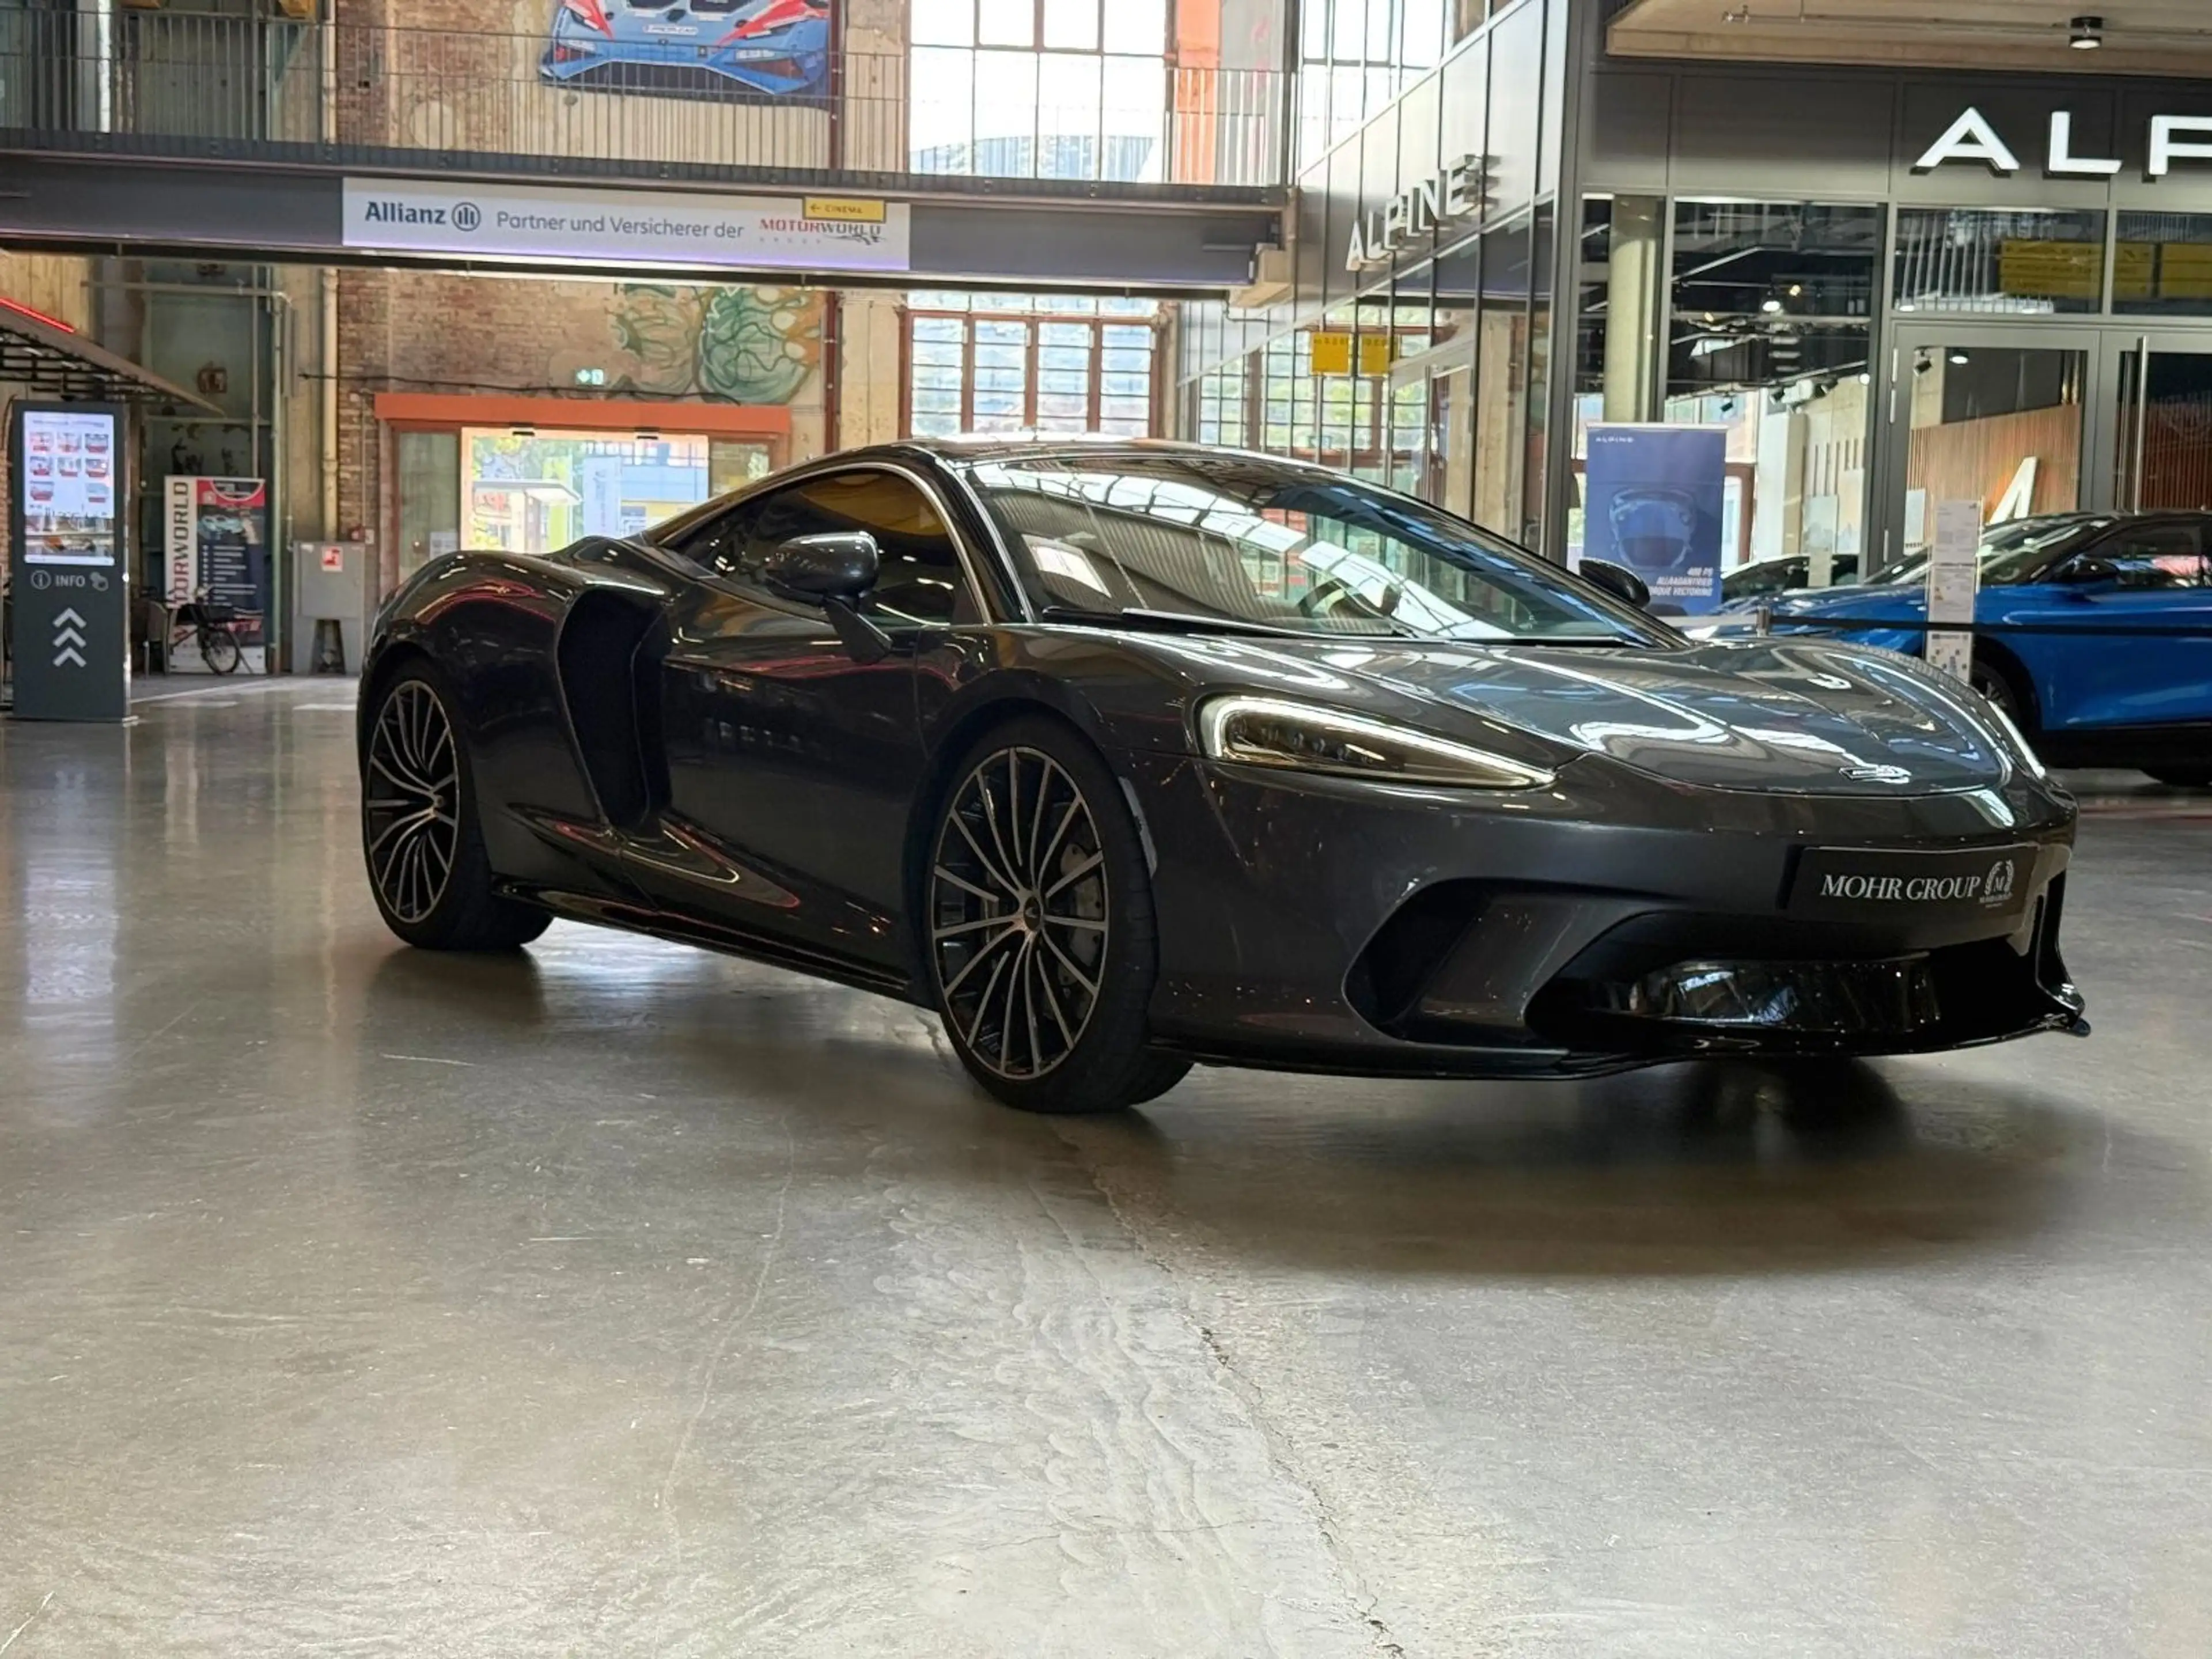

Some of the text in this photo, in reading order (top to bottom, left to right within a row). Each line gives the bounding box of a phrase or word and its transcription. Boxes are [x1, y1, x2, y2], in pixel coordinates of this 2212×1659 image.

[365, 200, 744, 238] Allianz Partner und Versicherer der
[1346, 154, 1480, 272] ALPINE
[55, 574, 85, 587] INFO
[1820, 874, 1903, 900] MOHR
[1906, 876, 1980, 900] GROUP
